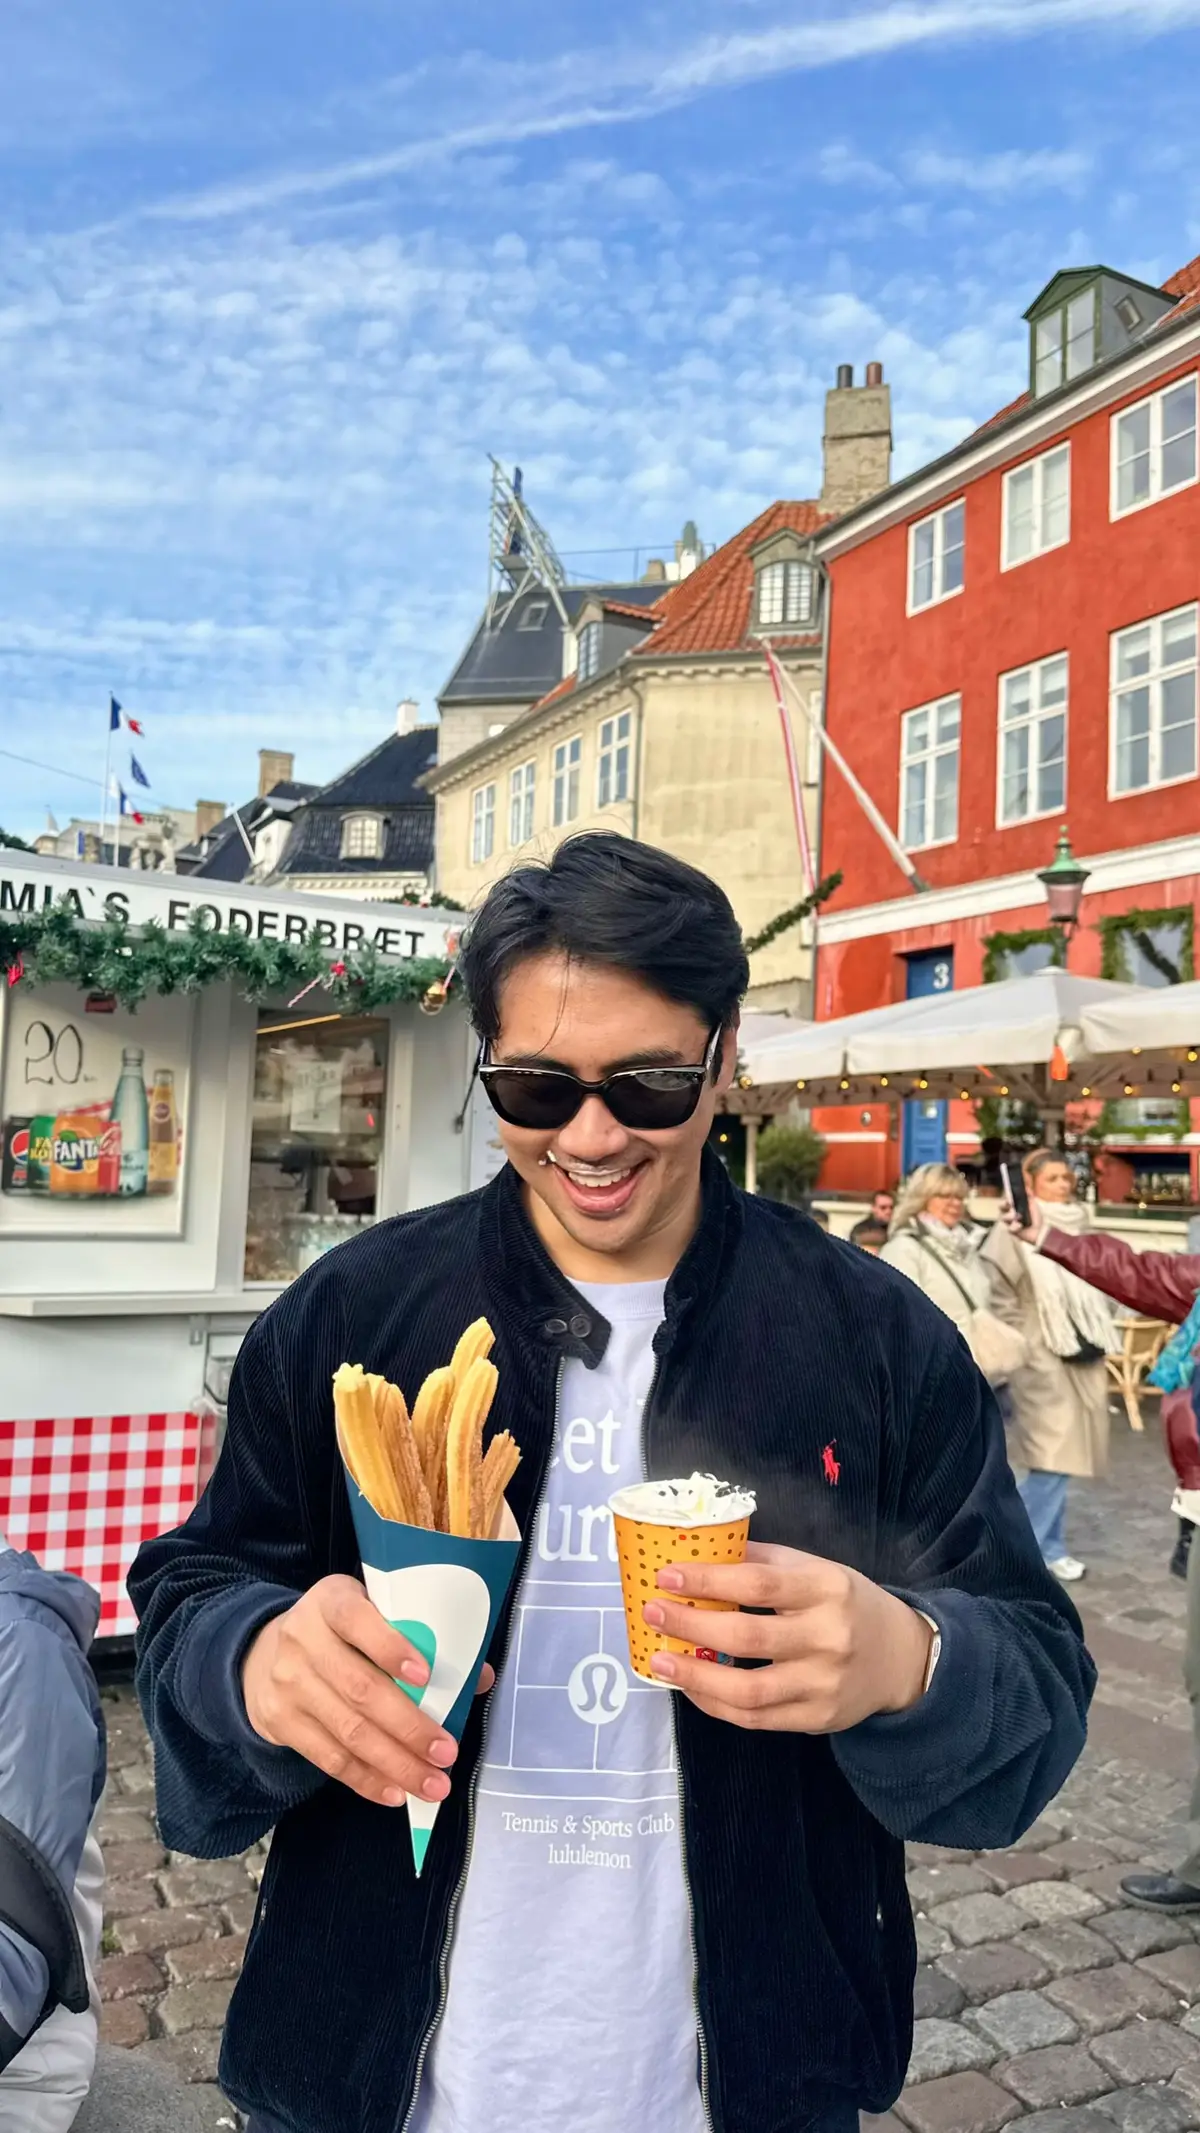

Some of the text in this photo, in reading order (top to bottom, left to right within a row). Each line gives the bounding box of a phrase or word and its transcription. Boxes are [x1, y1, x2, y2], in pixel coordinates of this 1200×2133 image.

[168, 900, 425, 960] FODERBRÆT
[933, 963, 950, 989] 3
[25, 1020, 83, 1085] 20
[551, 1409, 622, 1474] et
[501, 1812, 675, 1841] Tennis & Sports Club
[547, 1844, 632, 1869] lululemon
